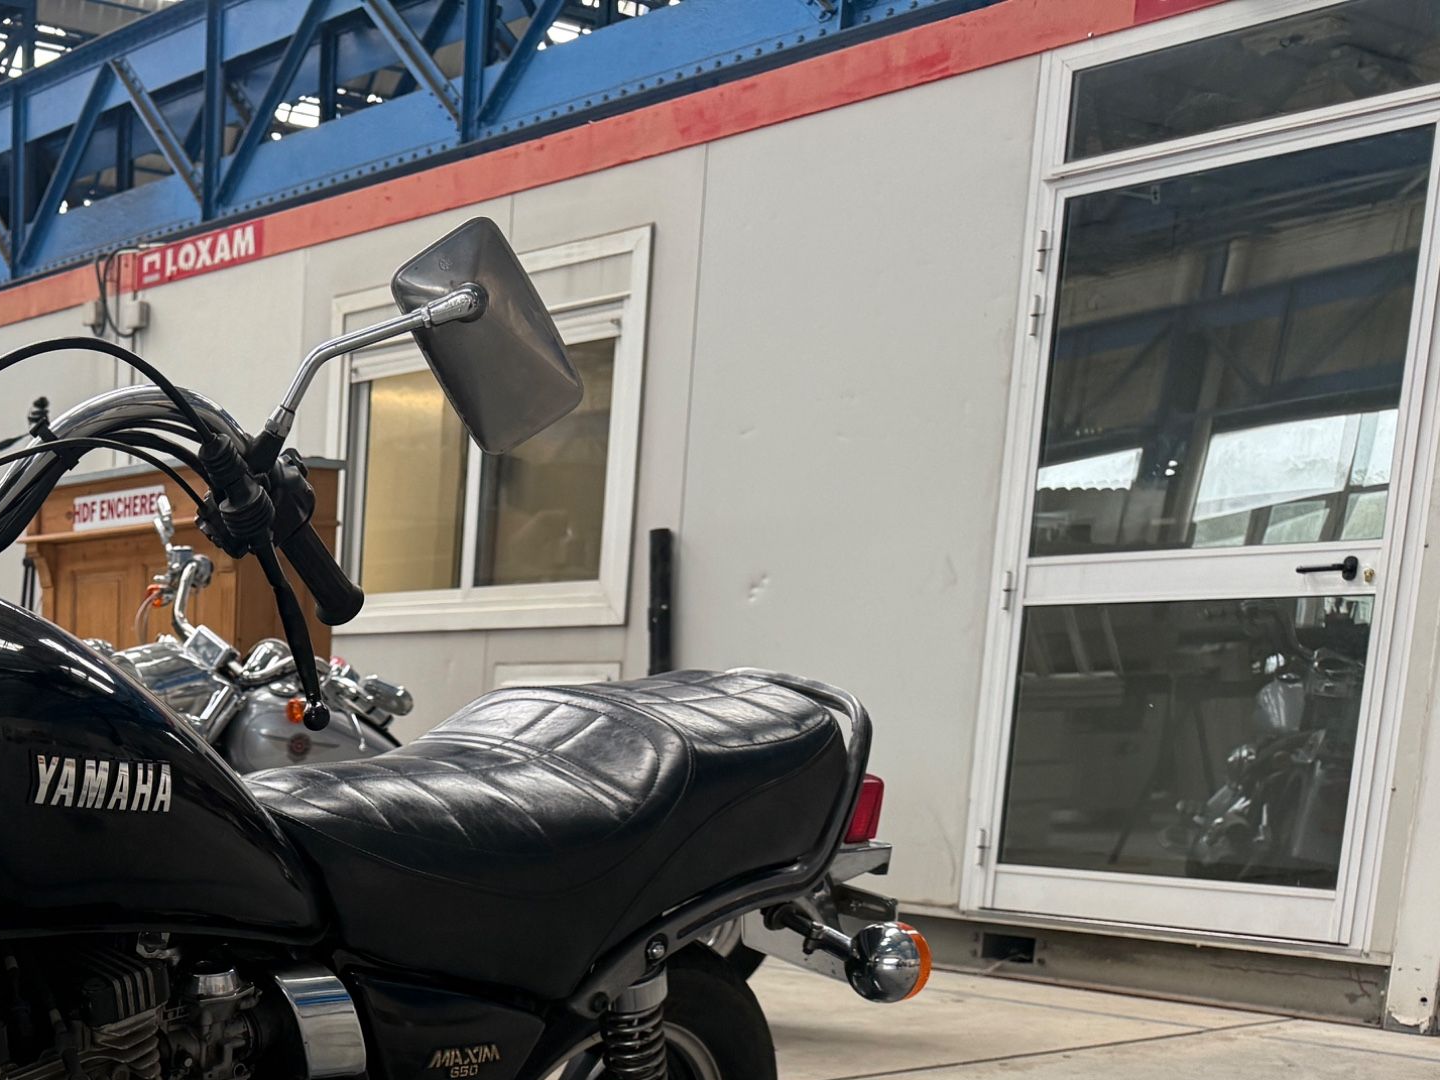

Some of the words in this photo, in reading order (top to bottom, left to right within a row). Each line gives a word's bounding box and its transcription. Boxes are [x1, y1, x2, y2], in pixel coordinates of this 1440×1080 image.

[164, 225, 256, 277] LOXAM
[73, 501, 96, 524] HDF
[100, 493, 162, 520] ENCHERE
[34, 754, 172, 813] YAMAHA
[427, 1044, 500, 1068] MAXIM
[450, 1064, 478, 1078] 650
